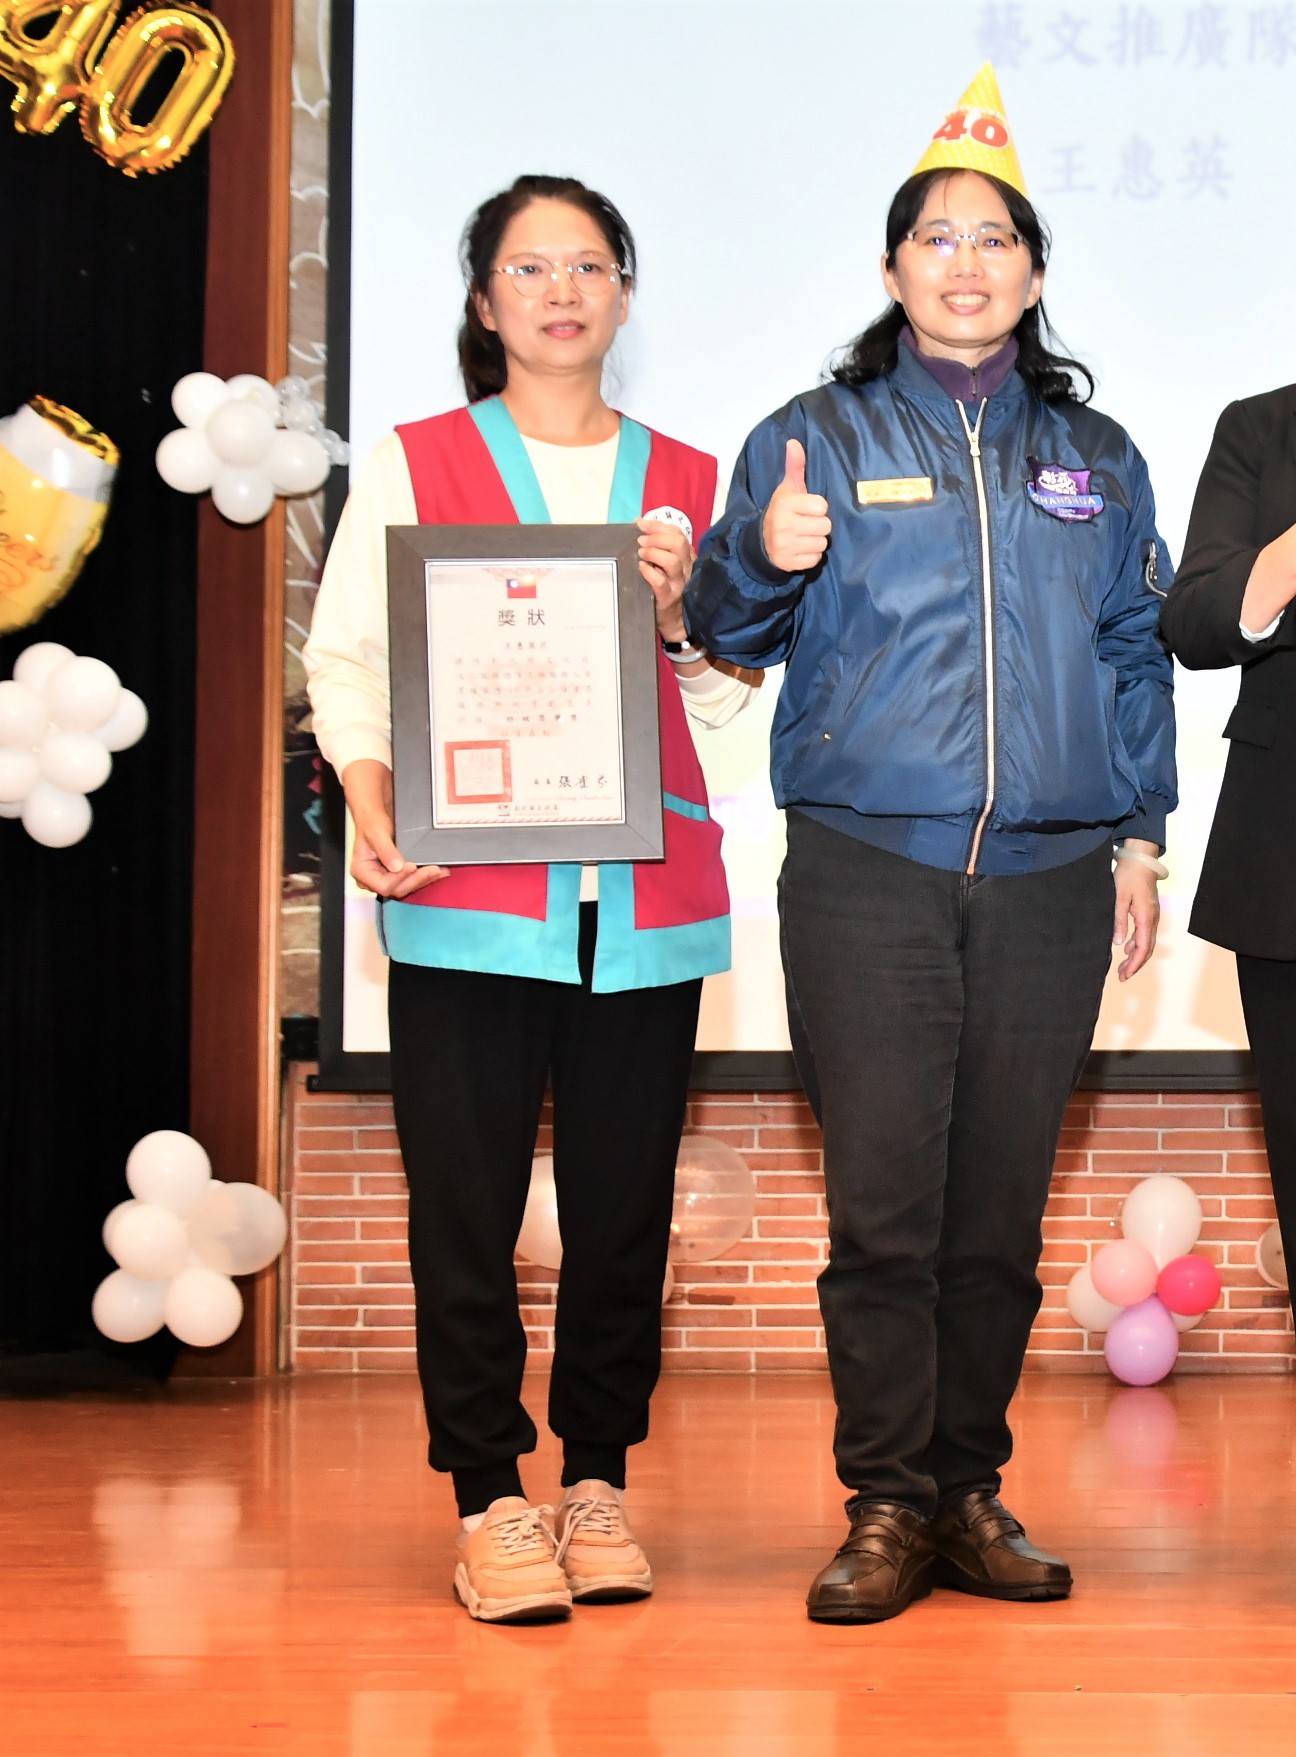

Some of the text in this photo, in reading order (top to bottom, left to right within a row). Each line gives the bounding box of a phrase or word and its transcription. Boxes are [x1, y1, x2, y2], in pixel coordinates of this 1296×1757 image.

[932, 109, 1009, 148] 40
[1041, 134, 1236, 201] 王惠英
[498, 608, 546, 626] 獎狀
